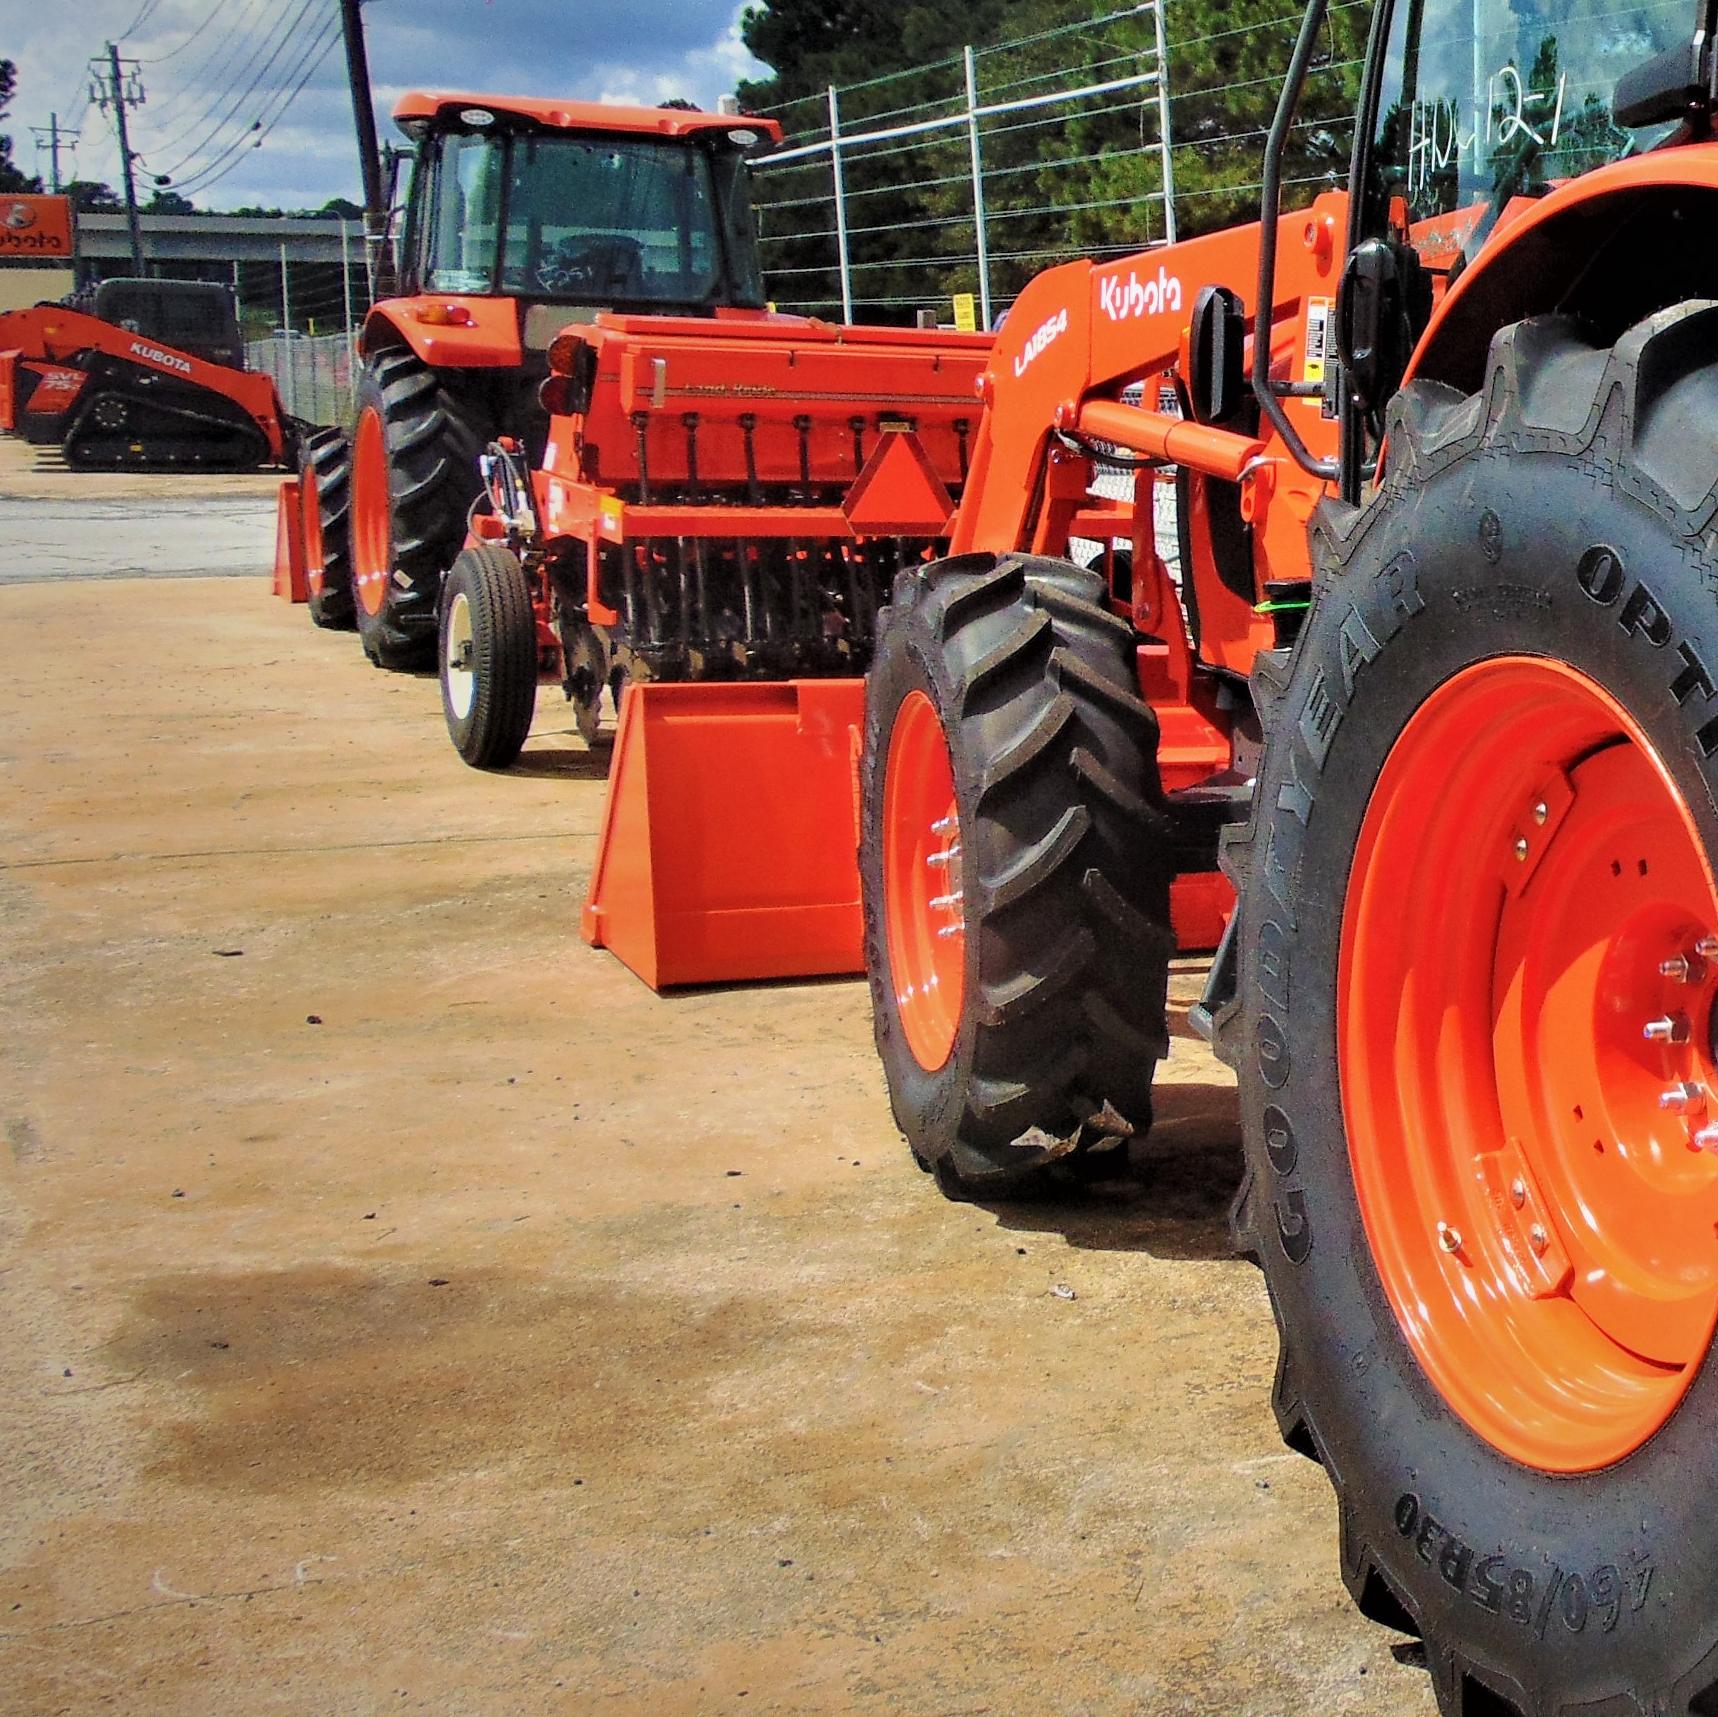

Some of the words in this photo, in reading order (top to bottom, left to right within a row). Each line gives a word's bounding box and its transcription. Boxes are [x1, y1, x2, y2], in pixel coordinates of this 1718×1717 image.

[1100, 266, 1182, 321] Kubota
[130, 341, 193, 374] KUBOTA
[1014, 307, 1069, 378] LA1854
[1258, 549, 1426, 1265] GOODYEAR
